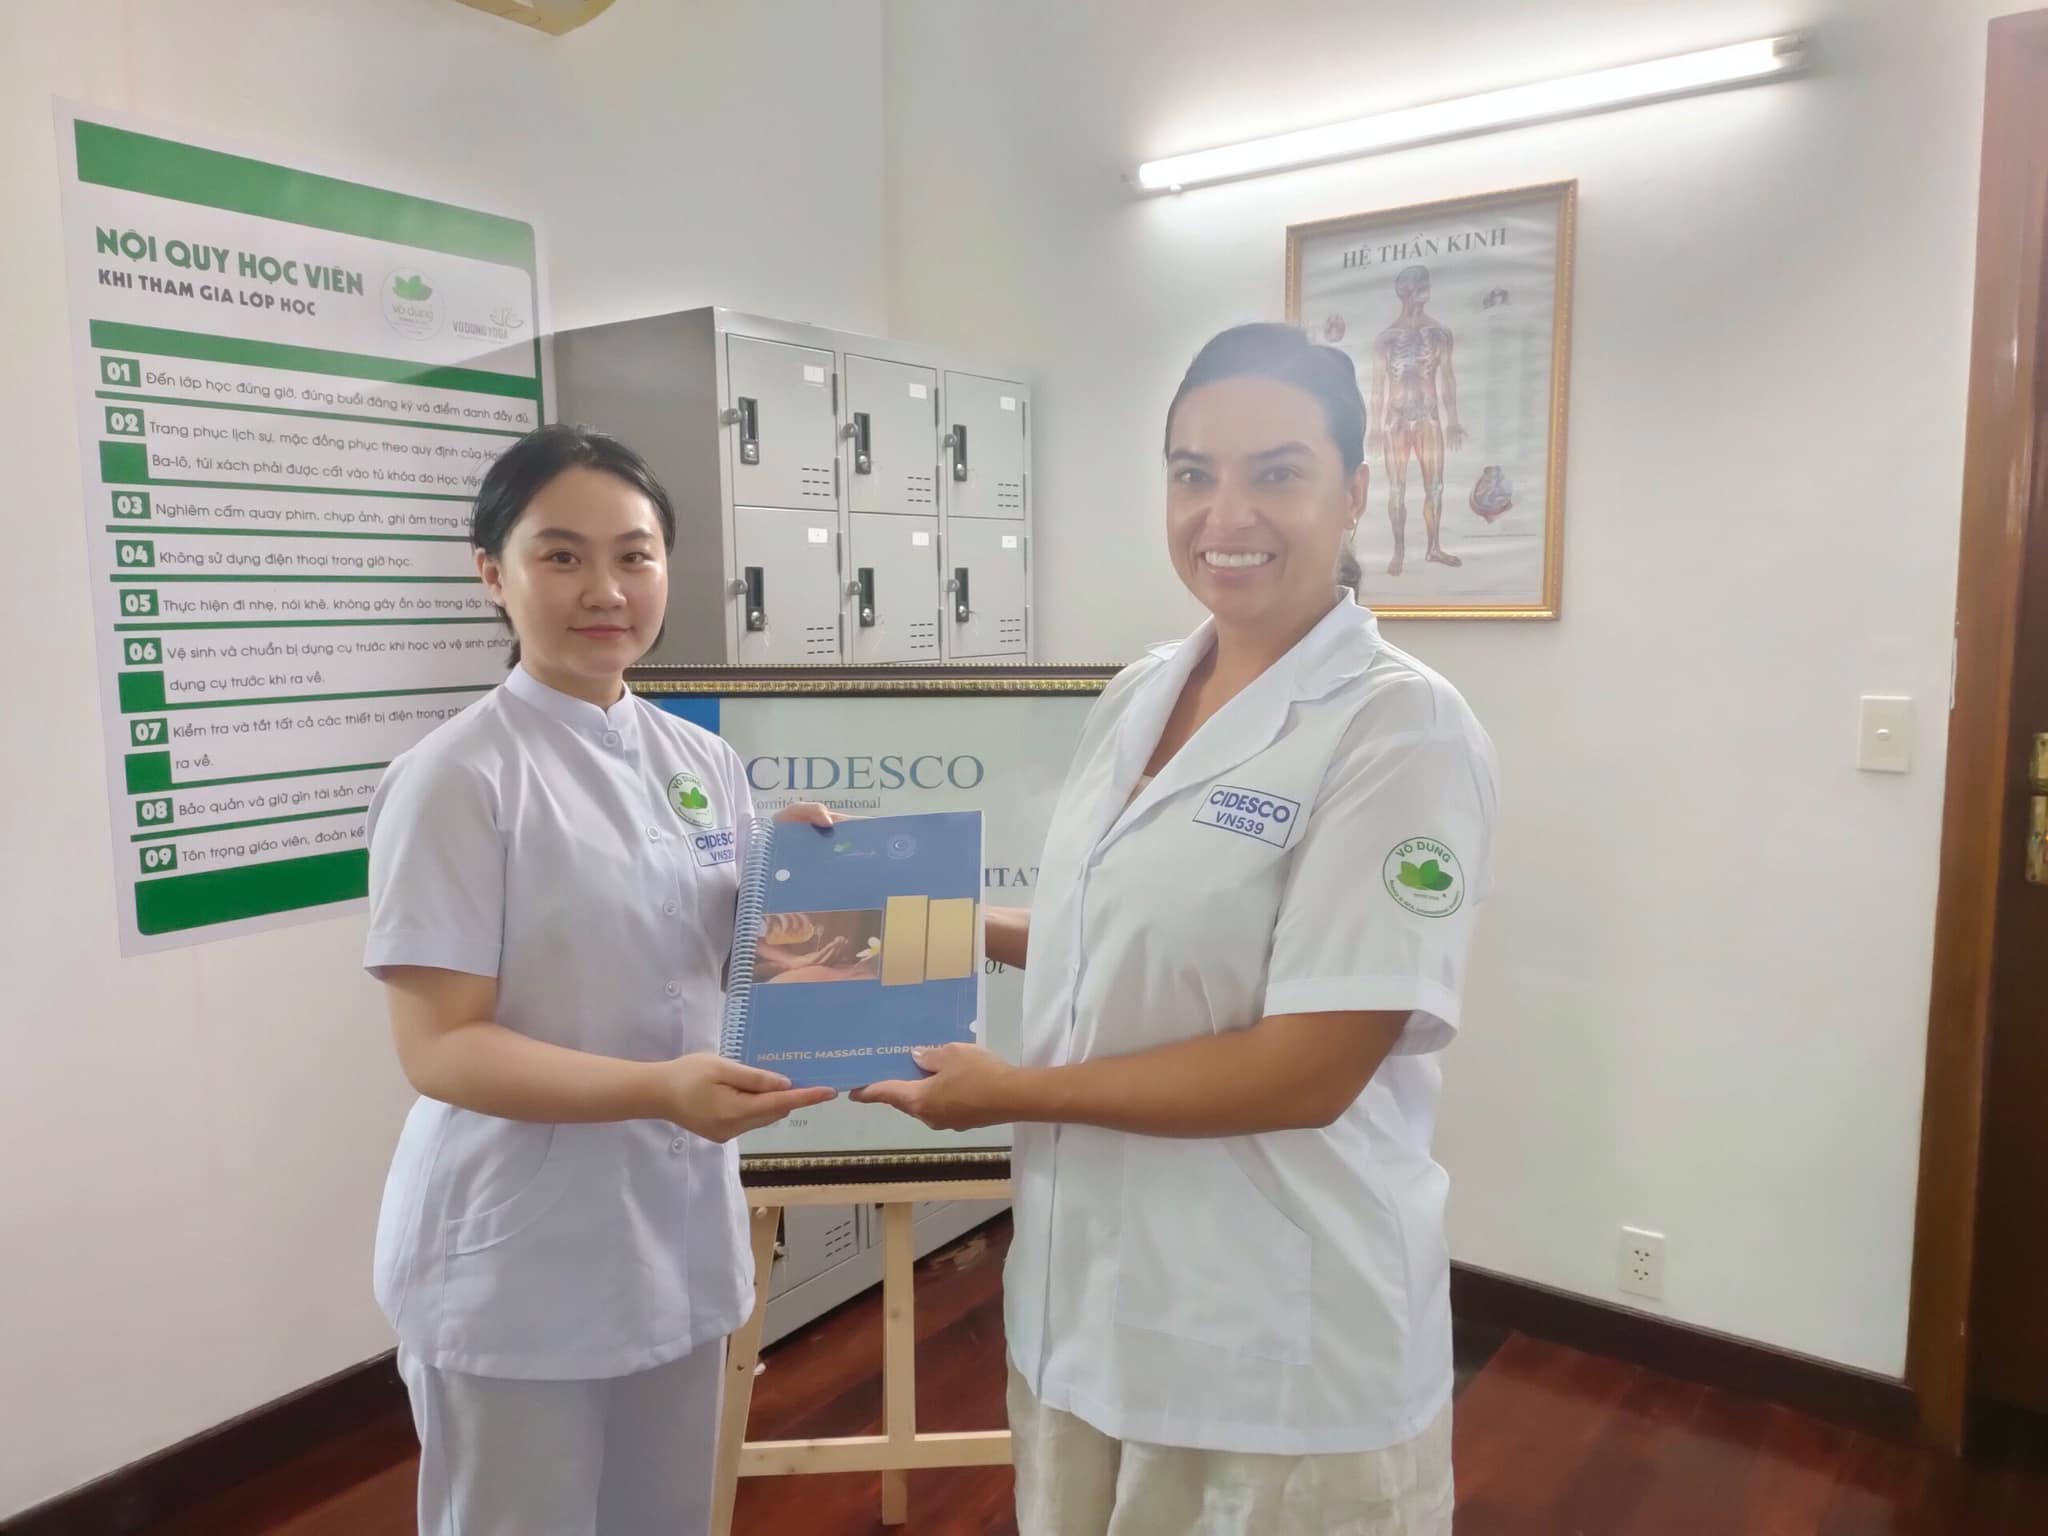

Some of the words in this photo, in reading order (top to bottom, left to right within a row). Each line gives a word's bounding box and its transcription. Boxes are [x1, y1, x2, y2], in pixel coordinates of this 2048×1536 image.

[95, 226, 157, 262] NỘI
[165, 239, 229, 274] QUY
[238, 251, 298, 285] HỌC
[304, 264, 364, 297] VIÊN
[1343, 243, 1371, 270] HỆ
[1378, 233, 1440, 263] THẦN
[1447, 227, 1506, 253] KINH
[98, 269, 132, 289] KHI
[138, 274, 194, 298] THAM
[200, 285, 234, 304] GIA
[107, 361, 130, 382] 01
[146, 371, 175, 386] Đến
[180, 375, 202, 389] lớp
[206, 378, 232, 392] học
[236, 382, 270, 398] đúng
[301, 389, 334, 405] đúng
[336, 392, 364, 405] buổi
[416, 403, 430, 413] và
[433, 402, 460, 416] điểm
[463, 407, 490, 419] danh
[111, 412, 139, 433] 02
[149, 421, 188, 438] Trang
[193, 425, 229, 440] phục
[233, 429, 255, 443] lịch
[279, 434, 309, 446] mặc
[312, 434, 345, 449] đồng
[348, 437, 378, 452] phục
[382, 441, 409, 454] theo
[411, 445, 432, 457] quy
[435, 446, 458, 459] định
[461, 447, 482, 460] của
[152, 454, 192, 469] Ba-lô,
[196, 457, 213, 469] túi
[216, 459, 250, 471] xách
[253, 460, 282, 474] phải
[286, 463, 319, 476] được
[322, 465, 343, 478] cất
[347, 467, 370, 479] vào
[387, 471, 416, 483] khóa
[419, 473, 434, 483] do
[437, 473, 459, 486] Học
[117, 495, 143, 514] 03
[156, 503, 210, 518] Nghiêm
[214, 504, 245, 518] cấm
[249, 509, 281, 521] quay
[323, 510, 355, 523] chụp
[387, 514, 405, 526] ghi
[409, 514, 427, 525] âm
[429, 515, 458, 528] trong
[121, 544, 149, 564] 04
[159, 551, 204, 566] Không
[207, 551, 223, 564] sử
[226, 553, 261, 567] dụng
[264, 553, 293, 567] điện
[296, 554, 328, 567] thoại
[332, 556, 363, 568] trong
[367, 557, 385, 568] giờ
[388, 557, 414, 568] học.
[124, 593, 151, 613] 05
[163, 600, 196, 613] Thực
[200, 600, 229, 613] hiện
[233, 600, 245, 610] đi
[249, 599, 277, 611] nhẹ,
[281, 599, 301, 610] nói
[333, 599, 370, 611] không
[374, 599, 395, 611] gây
[435, 599, 463, 610] trong
[129, 642, 157, 661] 06
[167, 647, 186, 661] Vệ
[190, 646, 216, 658] sinh
[220, 646, 237, 657] và
[241, 641, 283, 656] chuẩn
[286, 643, 299, 657] bị
[301, 643, 334, 656] dụng
[337, 643, 353, 654] cụ
[355, 641, 387, 653] trước
[389, 641, 405, 652] khi
[407, 640, 430, 652] học
[432, 639, 447, 650] và
[450, 639, 462, 650] vệ
[465, 638, 485, 649] sinh
[170, 679, 206, 692] dụng
[210, 678, 227, 690] cụ
[231, 675, 265, 689] trước
[269, 674, 287, 685] khi
[290, 676, 303, 685] ra
[135, 722, 162, 742] 07
[173, 722, 207, 738] Kiểm
[211, 724, 229, 736] tra
[233, 722, 249, 733] và
[275, 716, 293, 729] tất
[297, 715, 314, 729] cả
[317, 714, 342, 727] các
[345, 711, 371, 724] thiết
[374, 712, 386, 723] bị
[388, 710, 413, 723] điện
[416, 708, 445, 720] trong
[175, 759, 189, 769] ra
[745, 754, 985, 792] CIDESCO
[141, 800, 168, 821] 08
[178, 799, 206, 816] Bảo
[209, 797, 245, 813] quản
[248, 796, 265, 807] và
[268, 792, 288, 808] giữ
[291, 791, 311, 804] gìn
[314, 787, 330, 799] tài
[333, 785, 354, 798] sản
[1210, 790, 1290, 823] CIDESCO
[1216, 811, 1265, 835] VN539
[145, 847, 172, 868] 09
[183, 849, 206, 862] Tôn
[210, 845, 245, 860] trọng
[248, 841, 278, 856] giáo
[314, 830, 347, 845] đoàn
[1416, 840, 1451, 863] DUNG
[758, 1050, 812, 1062] HOLISTIC
[815, 1047, 873, 1059] MASSAGE
